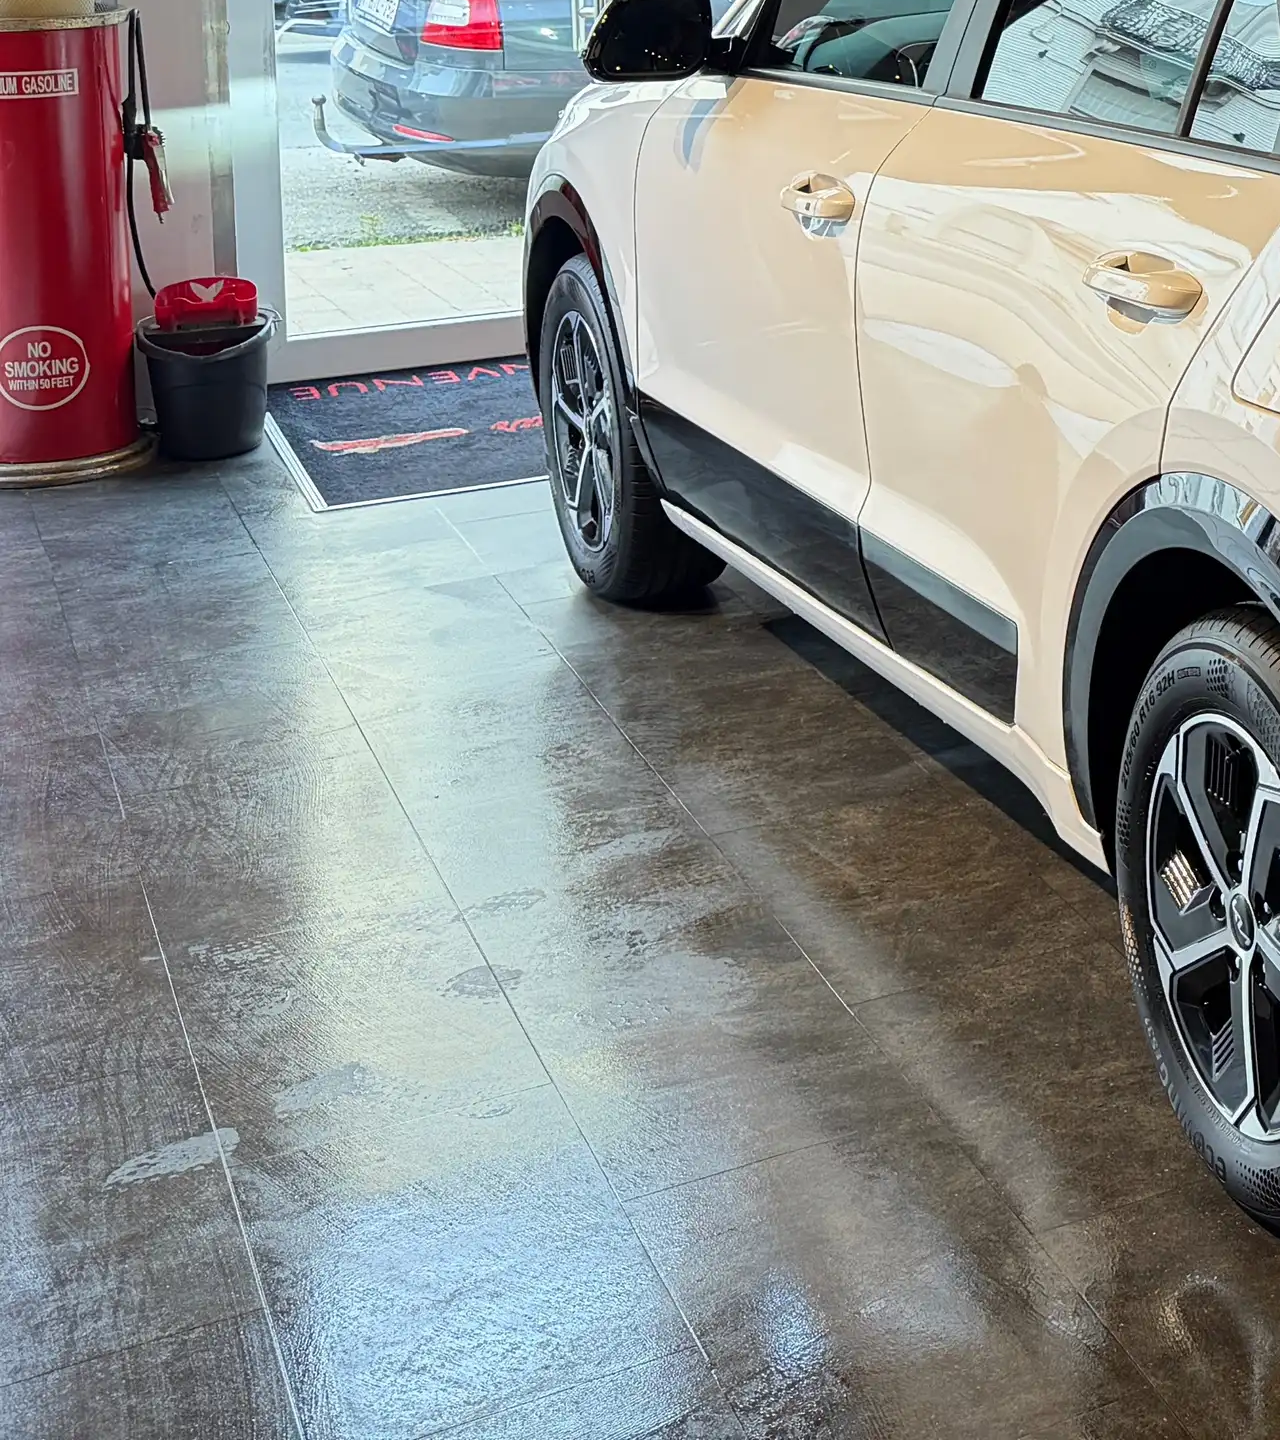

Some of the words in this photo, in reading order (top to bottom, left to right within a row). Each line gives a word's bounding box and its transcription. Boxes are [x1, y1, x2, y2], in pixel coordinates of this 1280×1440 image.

[22, 73, 73, 94] GASOLINE
[27, 341, 51, 358] NO
[5, 357, 79, 378] SMOKING
[8, 379, 39, 391] WITHIN
[40, 378, 50, 389] 50
[51, 375, 74, 389] FEET
[1156, 670, 1175, 696] 92H
